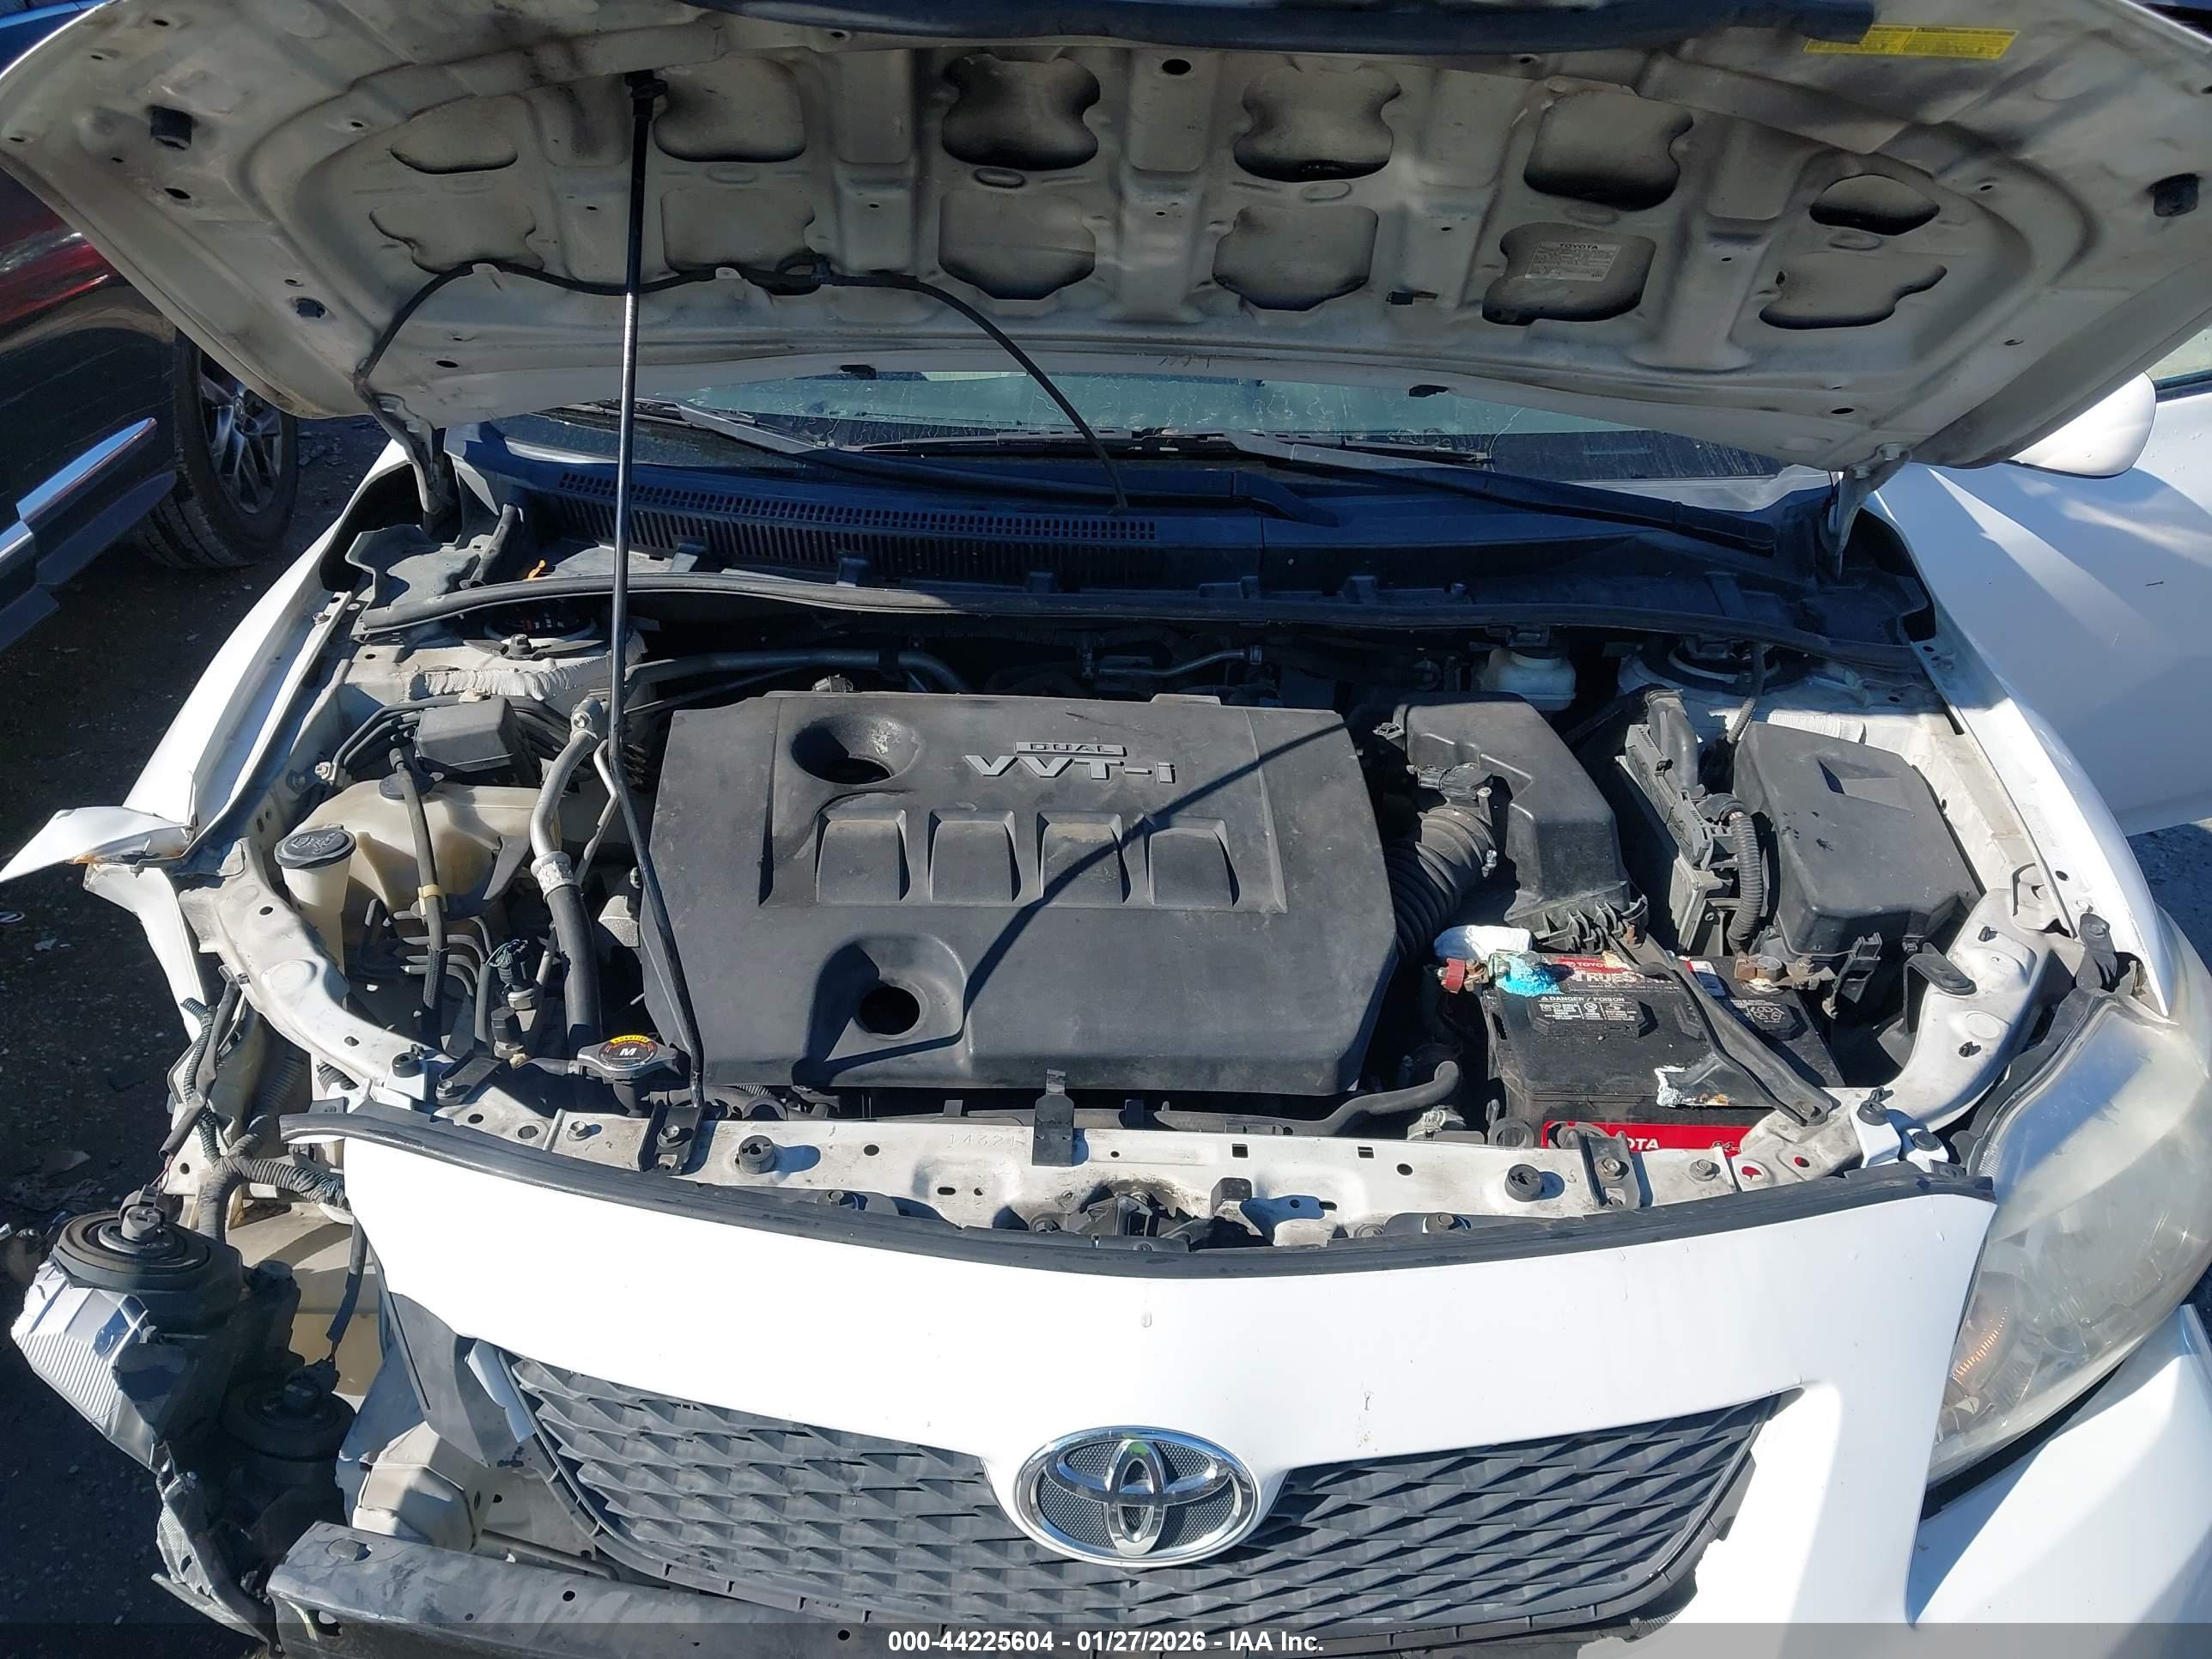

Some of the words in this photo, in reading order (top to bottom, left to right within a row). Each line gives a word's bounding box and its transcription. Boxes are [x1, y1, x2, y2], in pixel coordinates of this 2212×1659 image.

[1030, 742, 1116, 753] DUAL
[963, 755, 1176, 783] VVT-i
[619, 1048, 637, 1056] M
[1626, 1137, 1659, 1151] OTA
